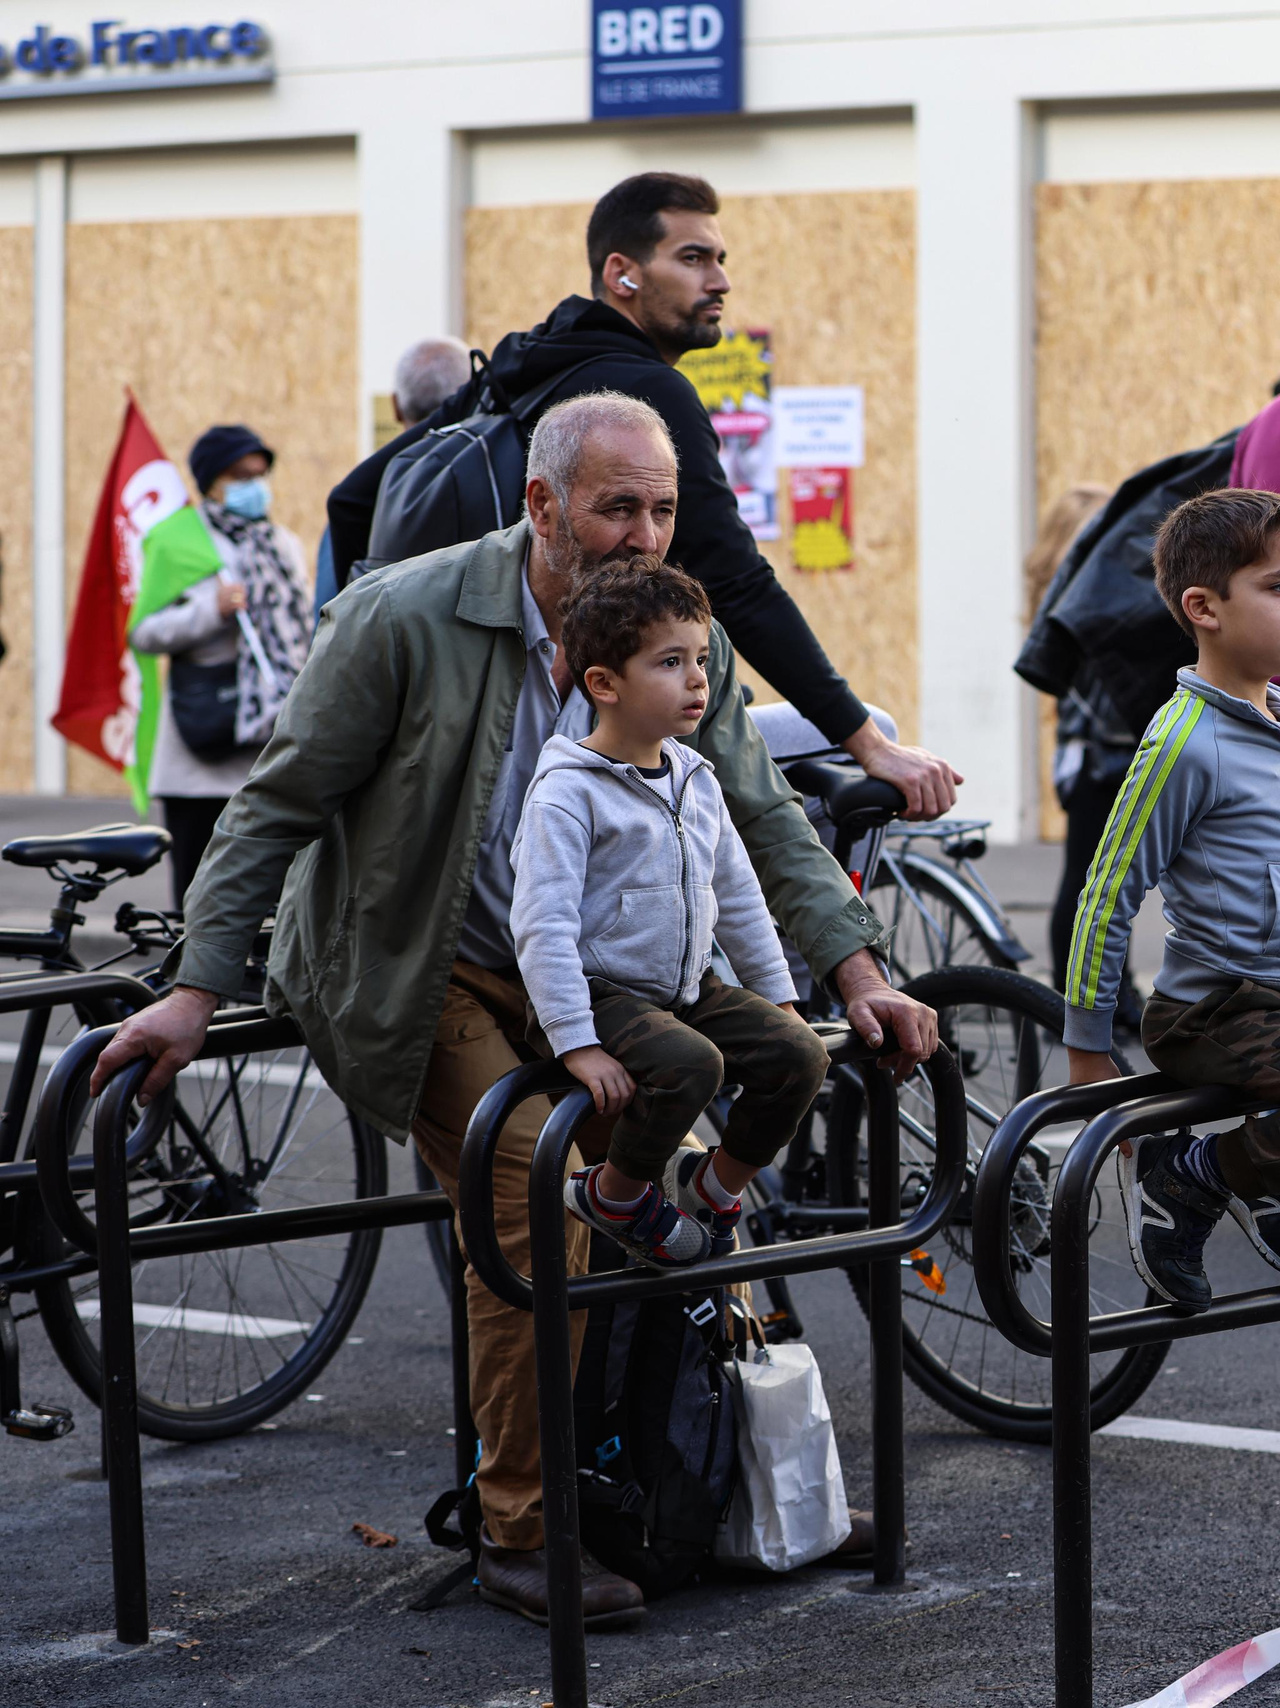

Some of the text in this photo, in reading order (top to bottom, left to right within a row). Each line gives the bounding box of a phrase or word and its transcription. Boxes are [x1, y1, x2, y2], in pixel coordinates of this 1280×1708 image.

[16, 24, 78, 72] de
[91, 21, 263, 66] France
[598, 4, 724, 57] BRED
